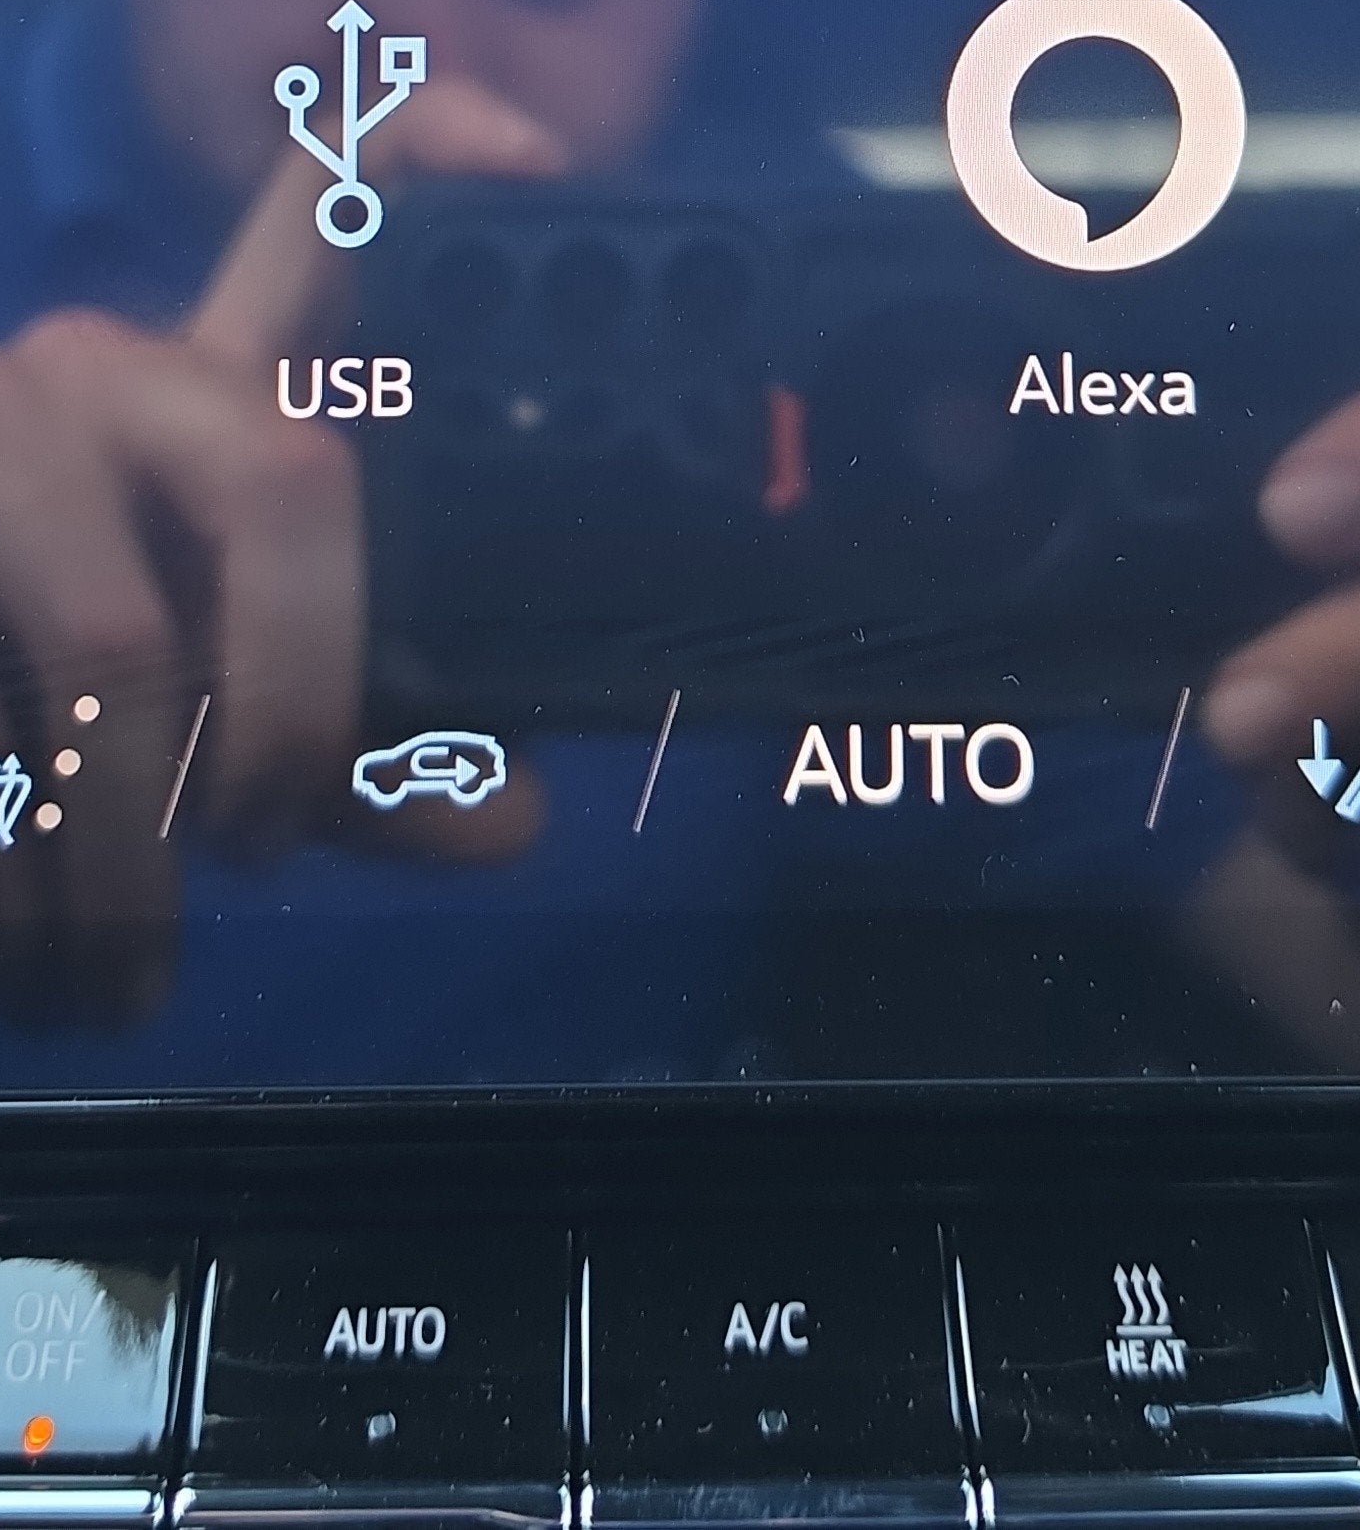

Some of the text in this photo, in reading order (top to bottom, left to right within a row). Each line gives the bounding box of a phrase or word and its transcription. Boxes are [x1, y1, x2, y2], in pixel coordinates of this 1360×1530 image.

[278, 357, 415, 420] USB
[1009, 354, 1197, 418] Alexa
[782, 722, 1035, 806] AUTO
[14, 1289, 107, 1335] ON/
[323, 1306, 446, 1357] AUTO
[723, 1302, 810, 1353] A/C
[4, 1339, 88, 1384] OFF
[1106, 1338, 1187, 1378] HEAT
